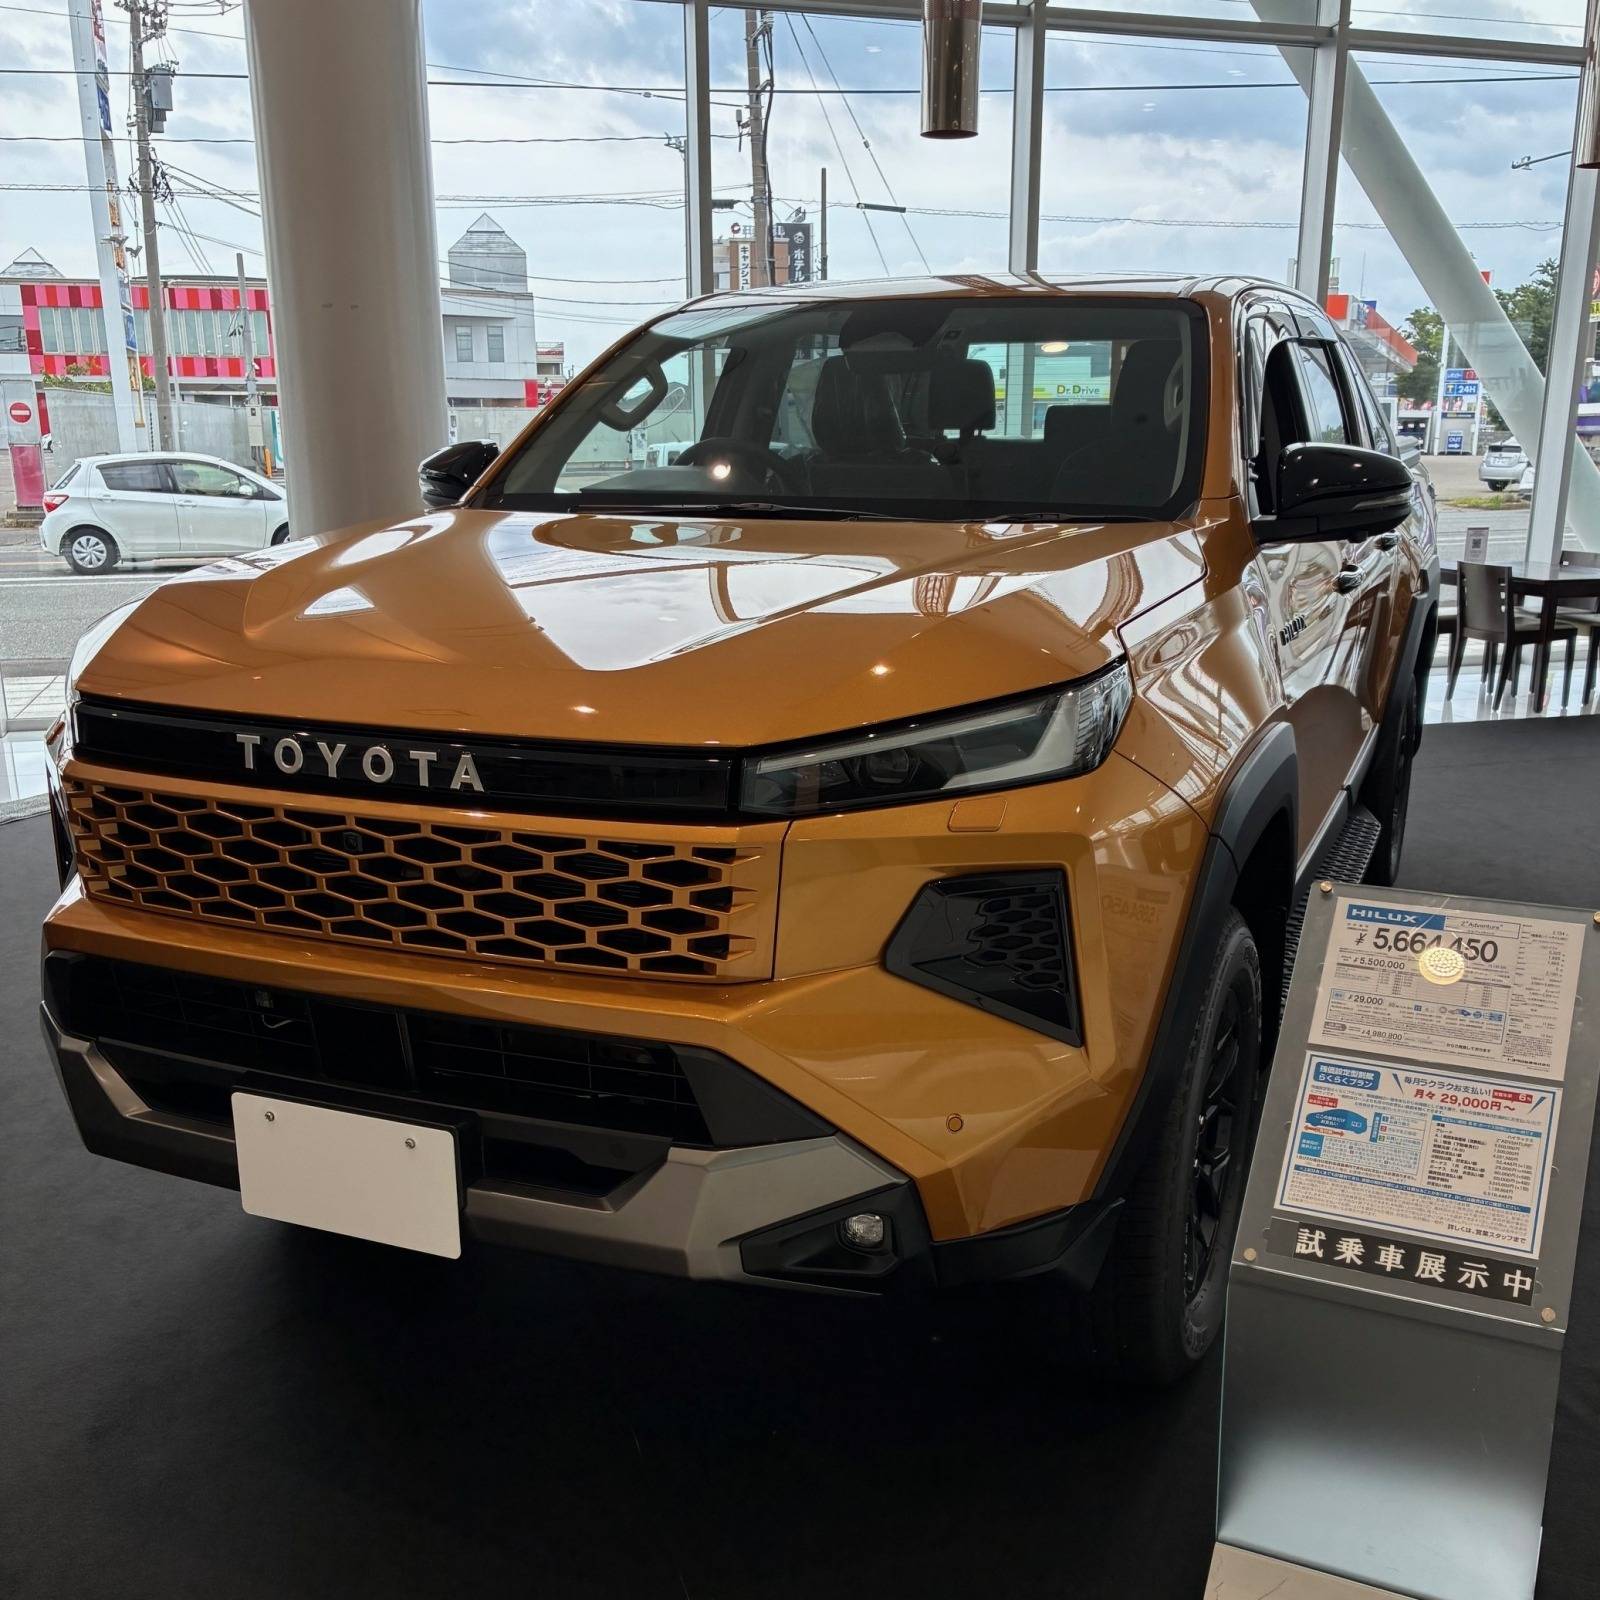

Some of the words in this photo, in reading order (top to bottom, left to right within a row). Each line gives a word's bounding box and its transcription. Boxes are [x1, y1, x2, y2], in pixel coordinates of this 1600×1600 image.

[794, 249, 805, 281] ホテル
[1458, 385, 1476, 394] 24H
[236, 733, 485, 793] TOYOTA
[1352, 908, 1417, 924] HILUX
[1373, 927, 1498, 963] 5,664450
[1318, 1074, 1373, 1088] らくらくプラン
[1296, 1228, 1532, 1297] 試乗車展示中
